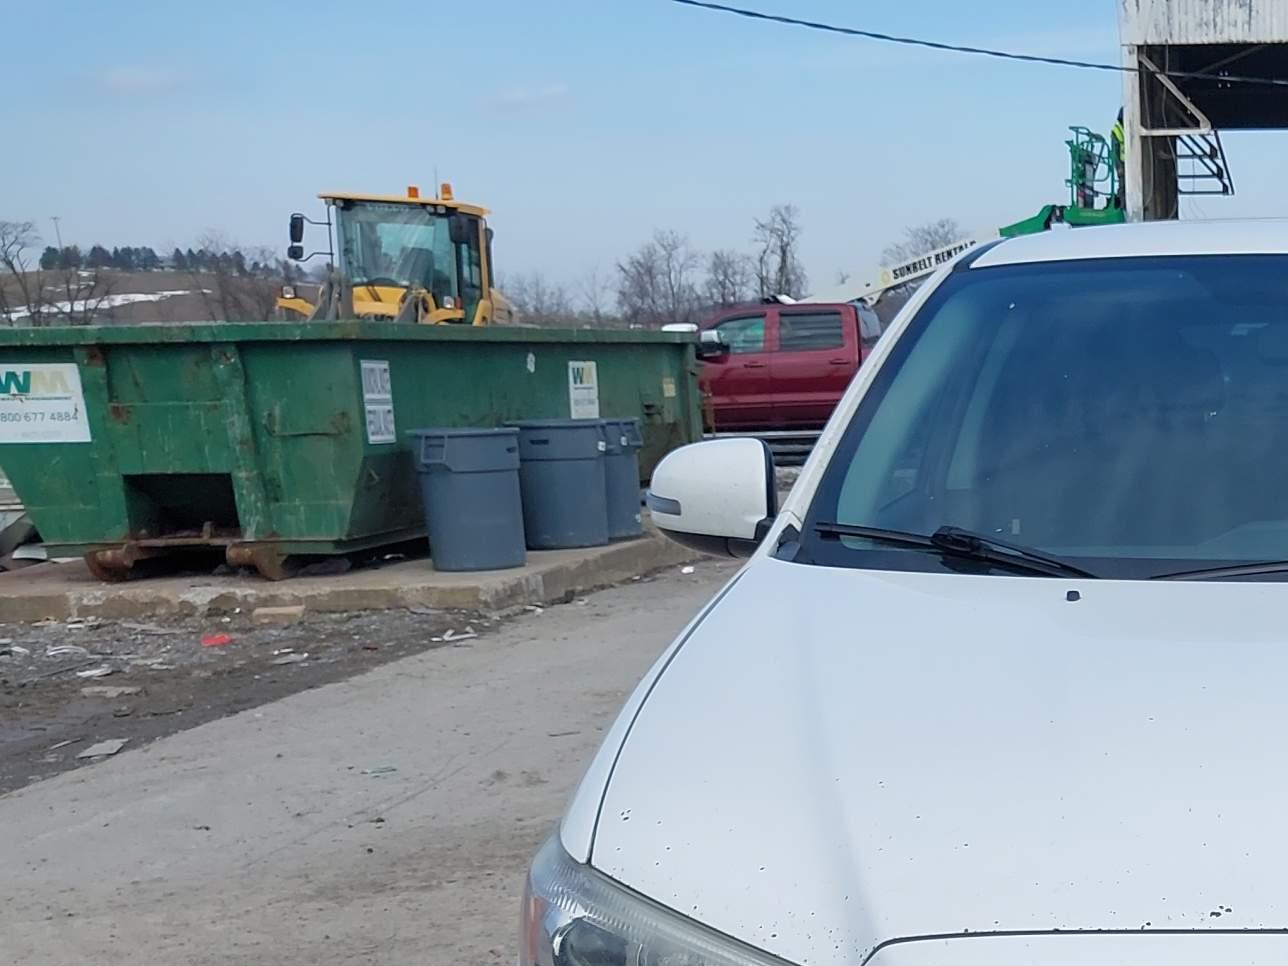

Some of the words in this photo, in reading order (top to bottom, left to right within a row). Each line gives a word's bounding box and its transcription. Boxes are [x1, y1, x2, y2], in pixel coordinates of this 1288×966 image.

[892, 256, 933, 280] SUNBELT
[0, 371, 69, 394] WM
[572, 367, 594, 385] WM
[24, 412, 45, 422] 677
